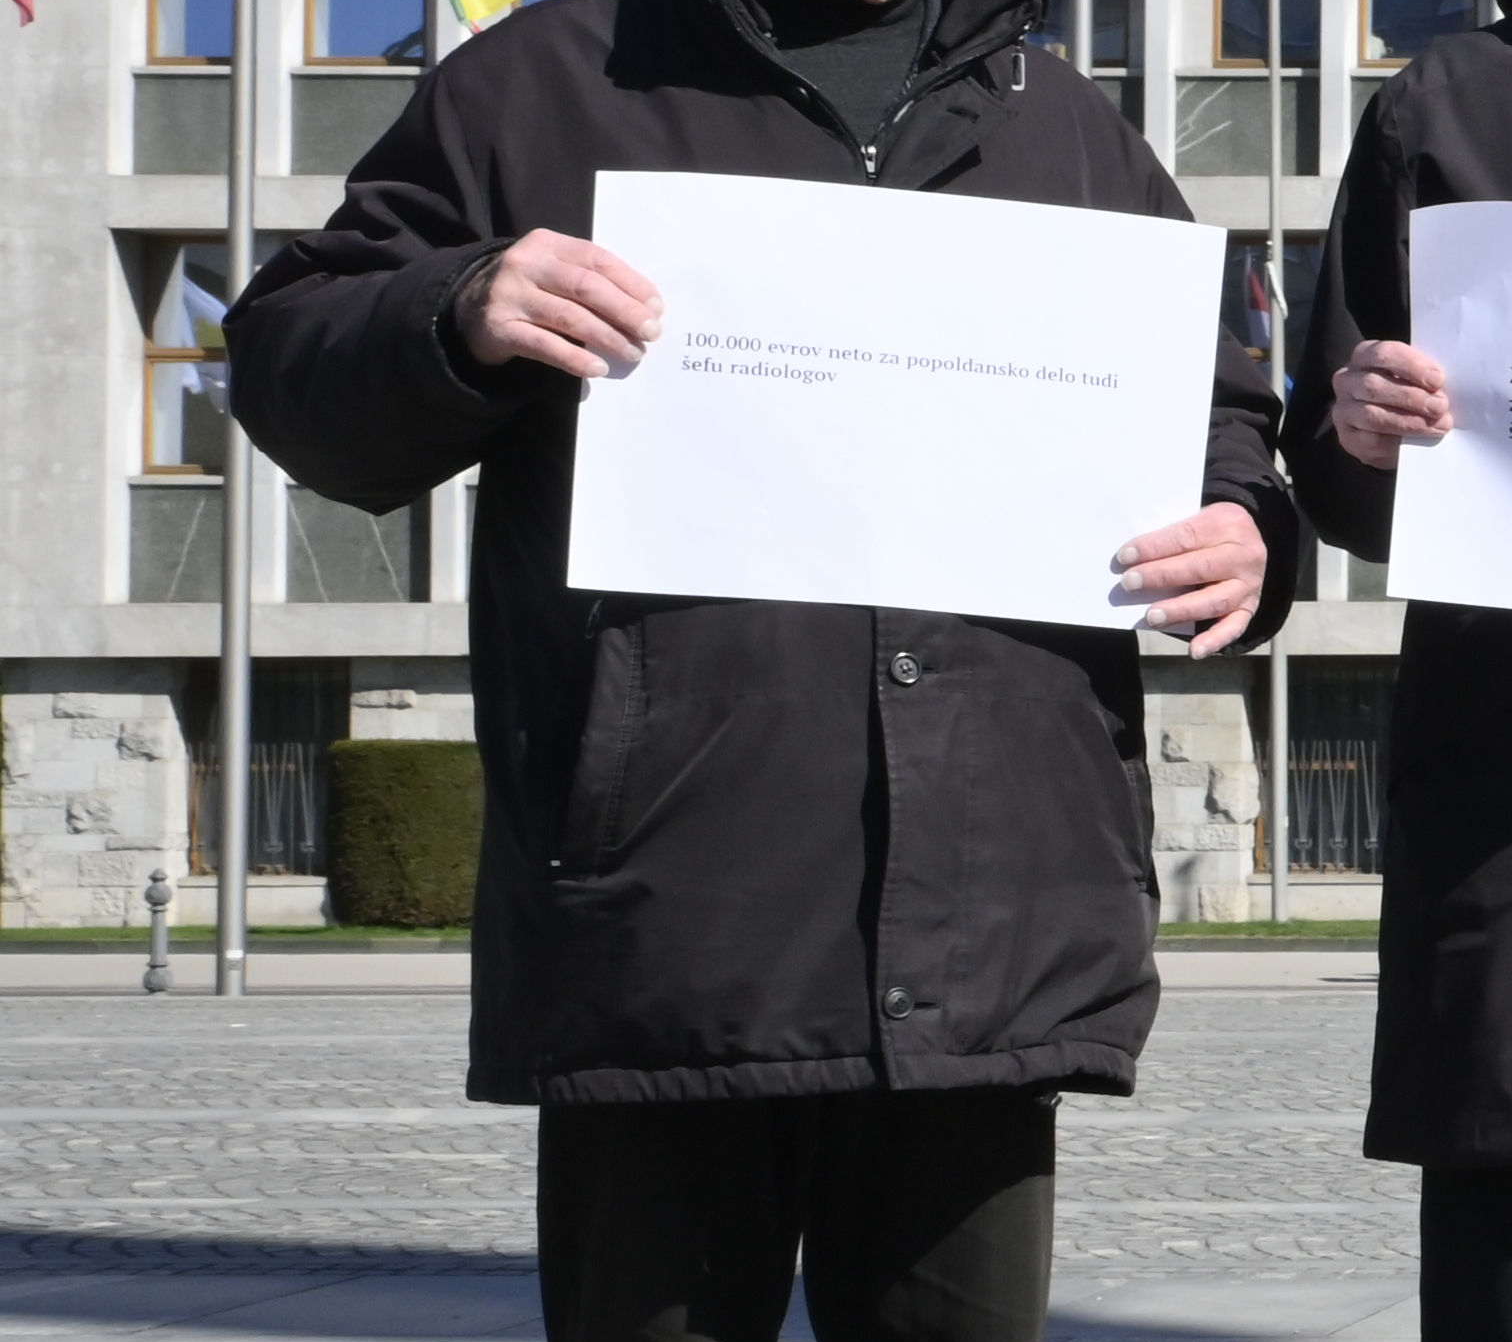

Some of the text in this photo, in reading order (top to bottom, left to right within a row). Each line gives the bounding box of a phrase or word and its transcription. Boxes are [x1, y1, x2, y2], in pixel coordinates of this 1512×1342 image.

[681, 355, 837, 385] šefu radiologov
[686, 332, 1118, 389] 100.000 evrov neto za popoldansko delo tudi
